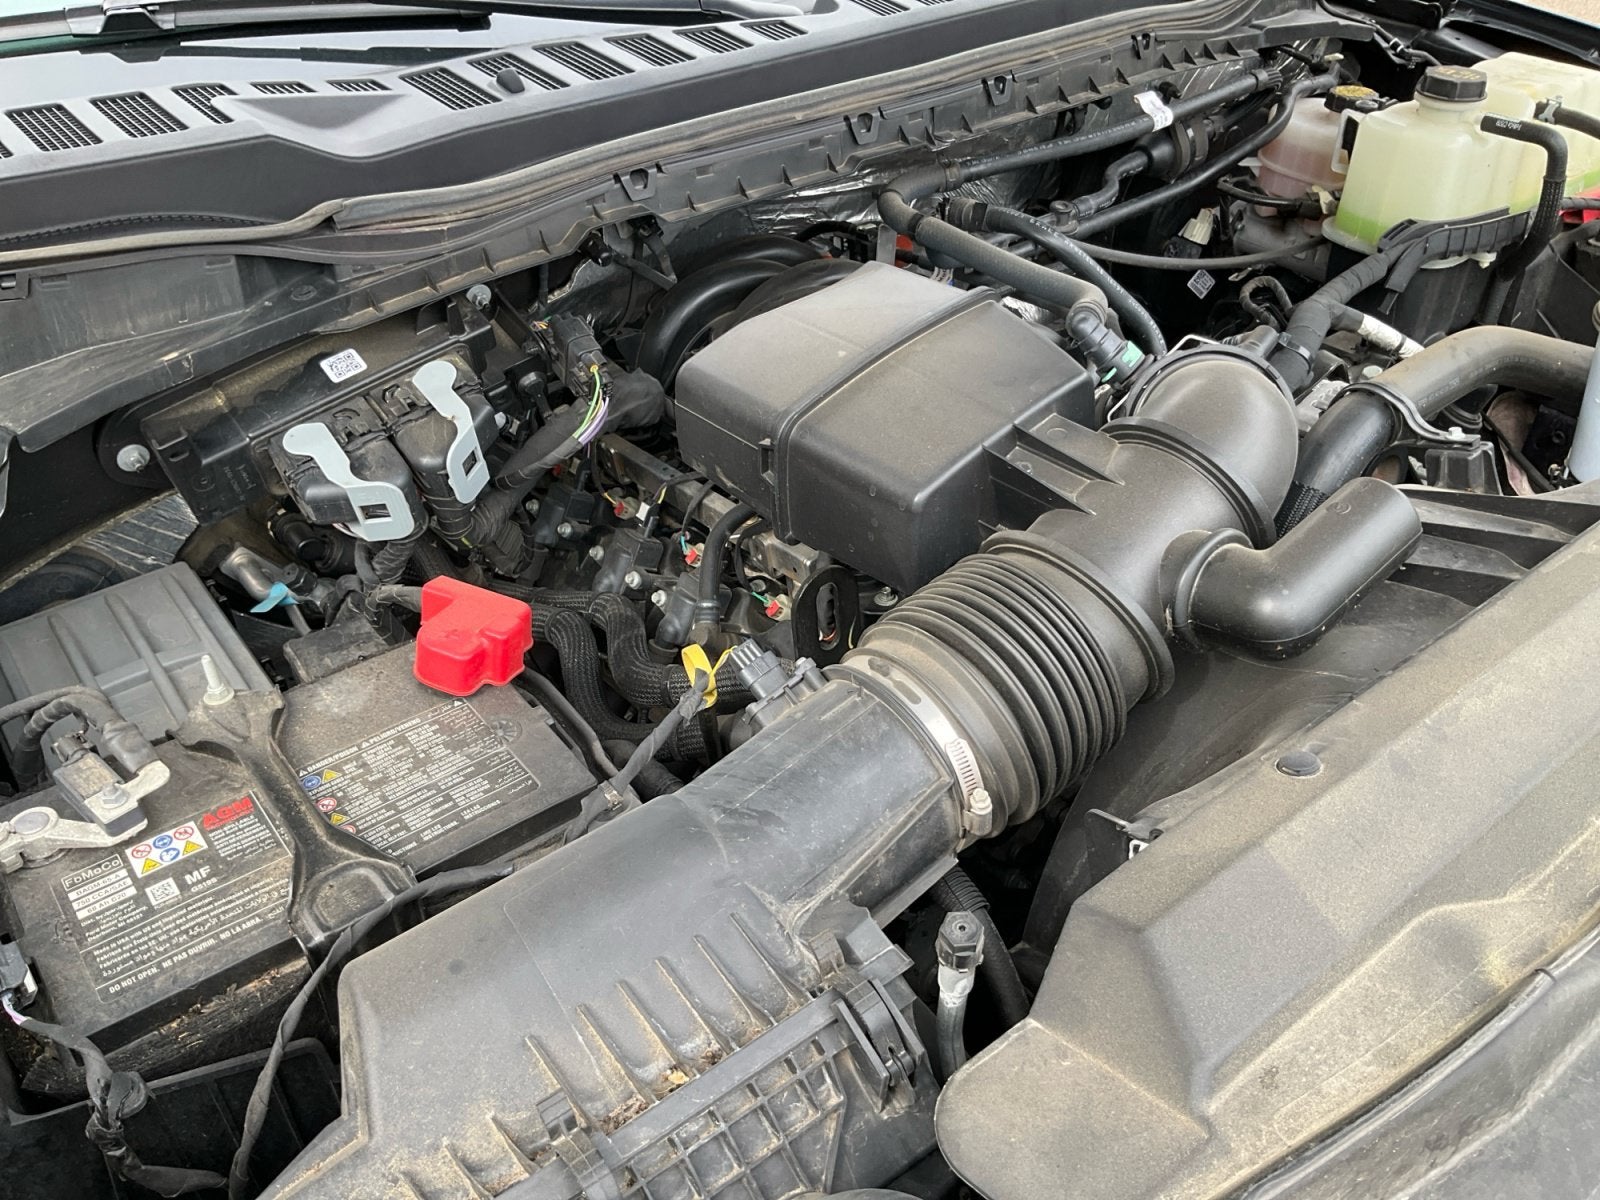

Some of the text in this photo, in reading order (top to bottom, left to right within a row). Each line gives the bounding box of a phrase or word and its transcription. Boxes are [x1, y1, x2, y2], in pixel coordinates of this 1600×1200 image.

[203, 797, 252, 826] AGM
[64, 859, 119, 887] FoMoCo
[184, 865, 210, 884] MF
[109, 983, 120, 993] DO
[120, 976, 136, 987] NOT
